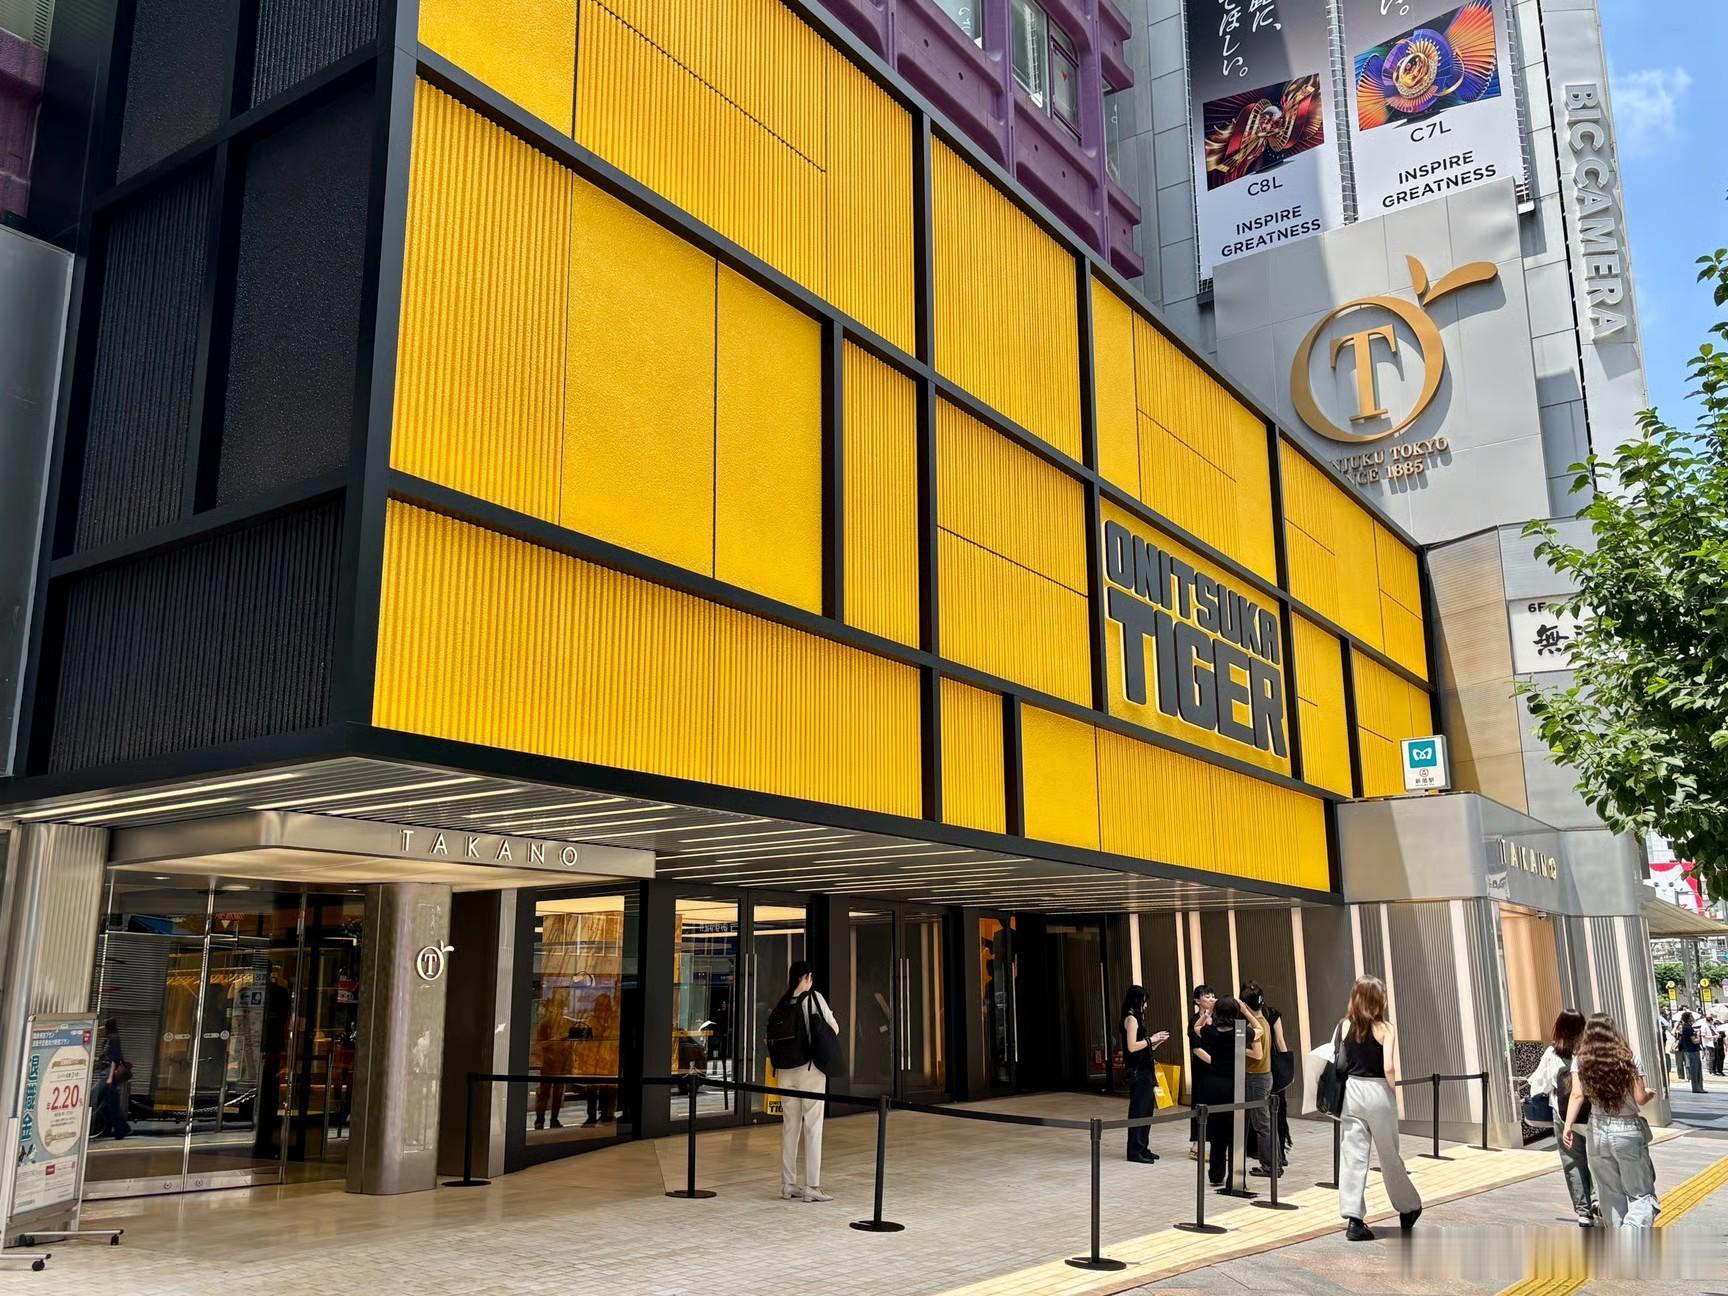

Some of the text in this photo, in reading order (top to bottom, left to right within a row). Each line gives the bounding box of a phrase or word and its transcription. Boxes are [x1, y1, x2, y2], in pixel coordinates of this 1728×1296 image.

[1410, 119, 1452, 143] C7L
[1398, 150, 1474, 185] INSPIRE
[1247, 176, 1284, 197] C8L
[1382, 164, 1497, 208] GREATNESS
[1221, 218, 1321, 257] GREATNESS
[1236, 205, 1302, 236] INSPIRE
[1390, 436, 1449, 461] TOKYO
[1385, 458, 1425, 480] 1885
[1104, 519, 1281, 666] ONITSUKA
[1107, 586, 1288, 759] TIGER
[399, 829, 578, 867] TAKANO
[1496, 837, 1557, 880] TAKANO
